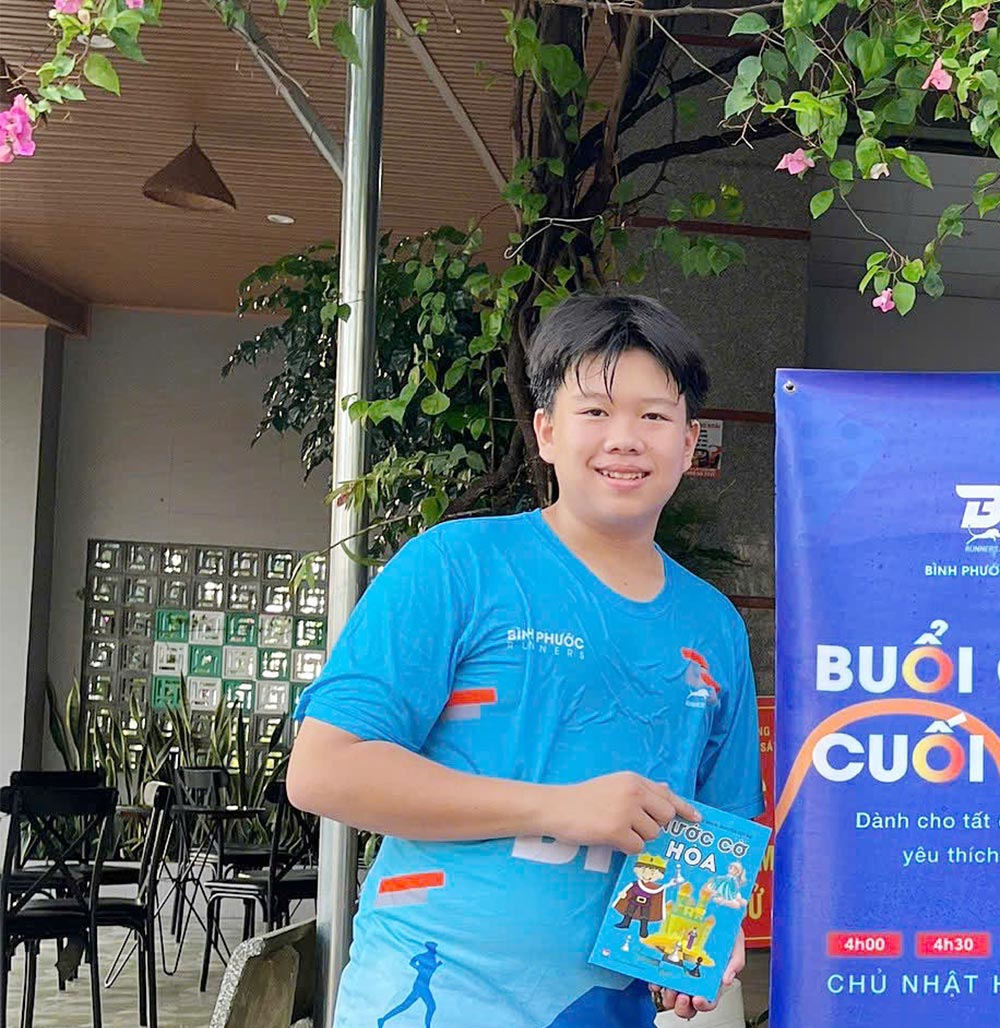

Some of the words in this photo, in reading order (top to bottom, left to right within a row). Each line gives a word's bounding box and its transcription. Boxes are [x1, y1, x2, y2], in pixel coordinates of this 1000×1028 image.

[924, 562, 957, 577] BÌNH
[535, 630, 585, 650] PHƯỚC
[815, 619, 973, 695] BUỔI
[812, 711, 984, 784] CUỐI
[855, 811, 909, 830] Dành
[917, 812, 955, 830] cho
[963, 810, 991, 830] tất
[902, 847, 939, 868] yêu
[947, 846, 999, 864] thích
[843, 936, 886, 952] 4h00
[933, 936, 974, 952] 4h30
[827, 967, 887, 994] CHỦ
[902, 969, 979, 998] NHẬT
